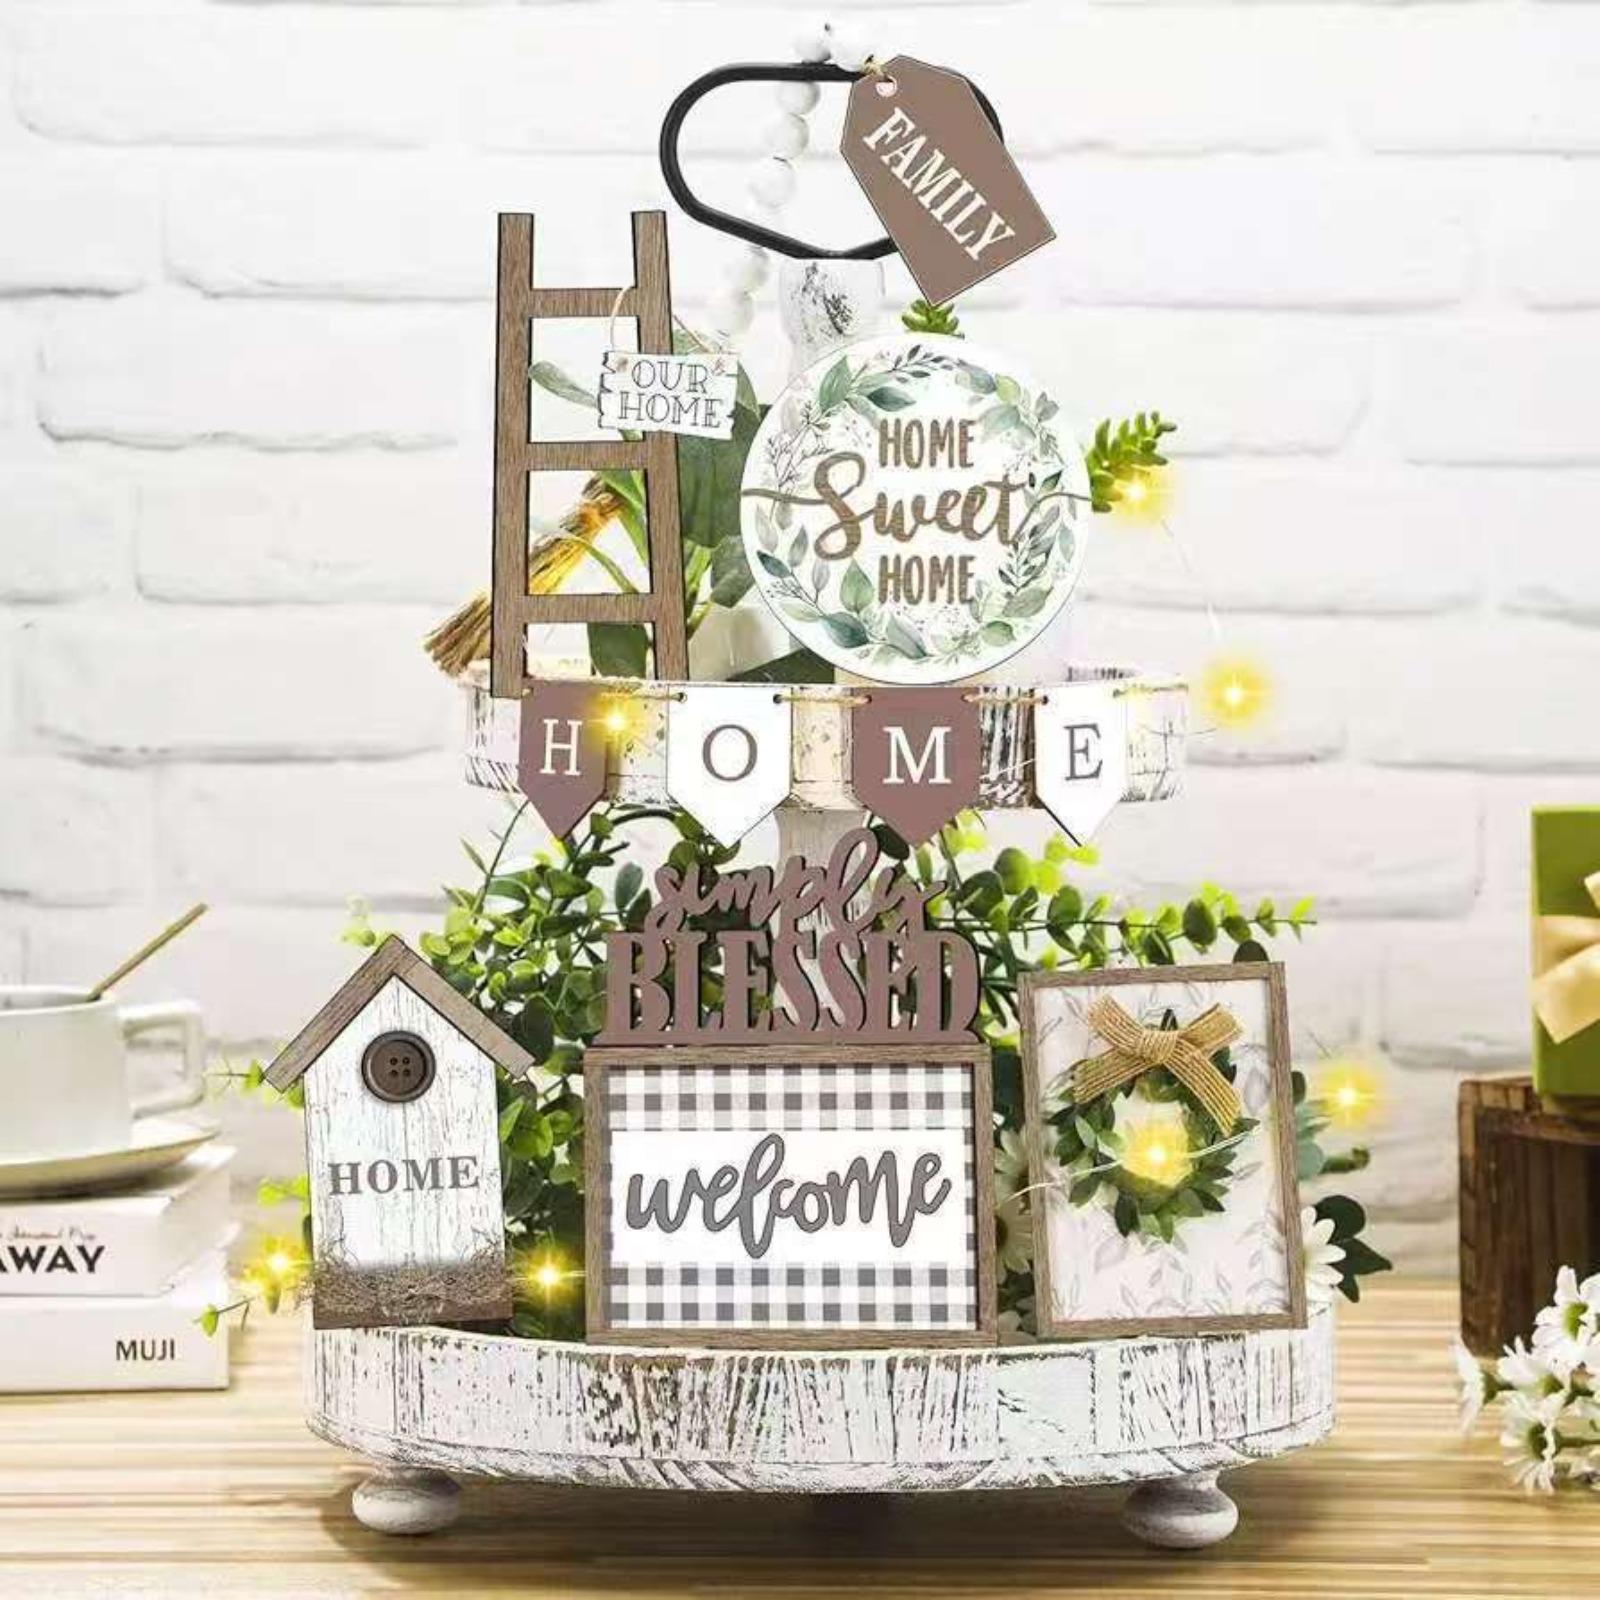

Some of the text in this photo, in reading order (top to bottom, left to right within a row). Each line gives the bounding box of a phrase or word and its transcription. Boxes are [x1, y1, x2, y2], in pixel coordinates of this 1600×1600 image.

[862, 106, 1016, 261] FAMILY
[631, 359, 708, 394] OUR
[617, 390, 722, 428] HOME
[878, 418, 977, 469] HOME
[812, 450, 1028, 562] Sweet
[877, 554, 978, 606] HOME
[643, 827, 946, 940] simply
[604, 929, 982, 1034] BLESSED
[327, 1155, 480, 1196] HOME
[625, 1132, 952, 1259] welcome
[115, 1338, 176, 1361] MUJI
